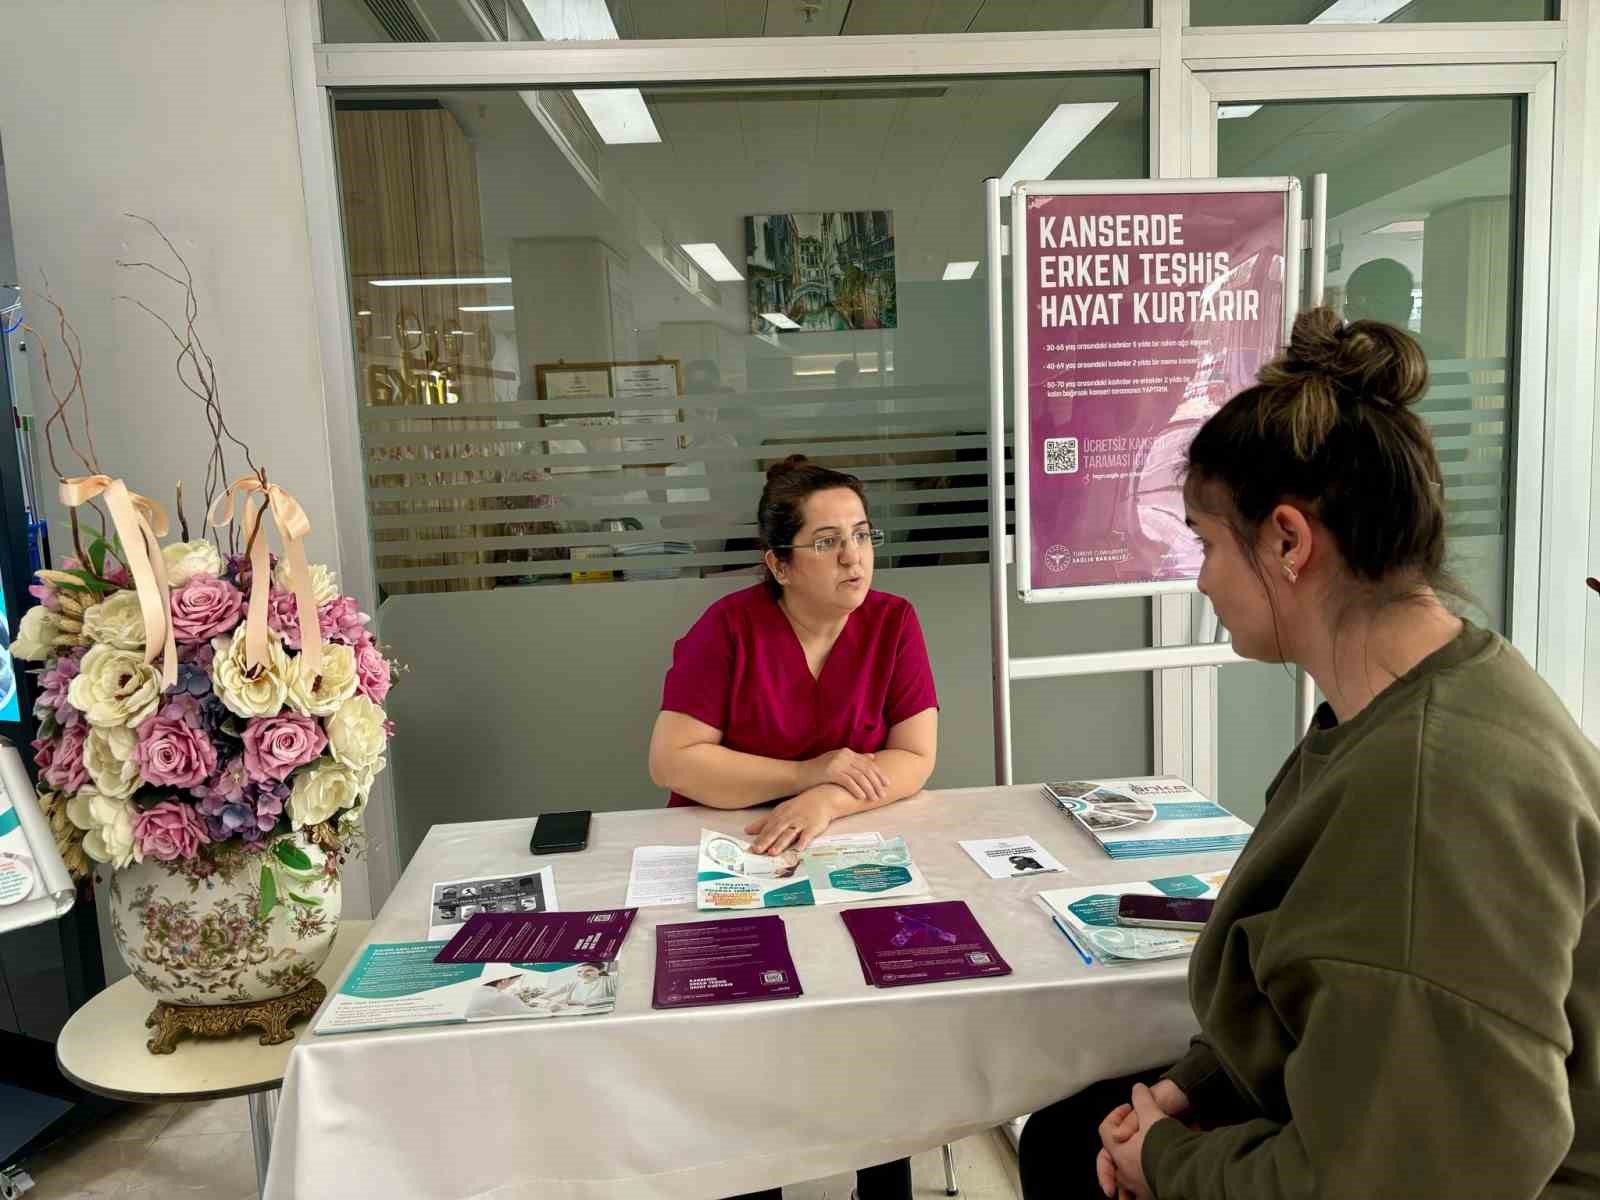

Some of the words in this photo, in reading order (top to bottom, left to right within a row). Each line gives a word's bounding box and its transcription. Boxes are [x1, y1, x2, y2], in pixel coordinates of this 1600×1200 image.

[1039, 213, 1184, 249] KANSERDE
[1040, 253, 1129, 289] ERKEN
[1139, 251, 1230, 287] TEŞHİS
[1040, 293, 1123, 328] HAYAT
[1133, 289, 1259, 325] KURTARIR
[1083, 435, 1128, 453] ÜCRETSİZ
[1083, 453, 1130, 470] TARAMASI
